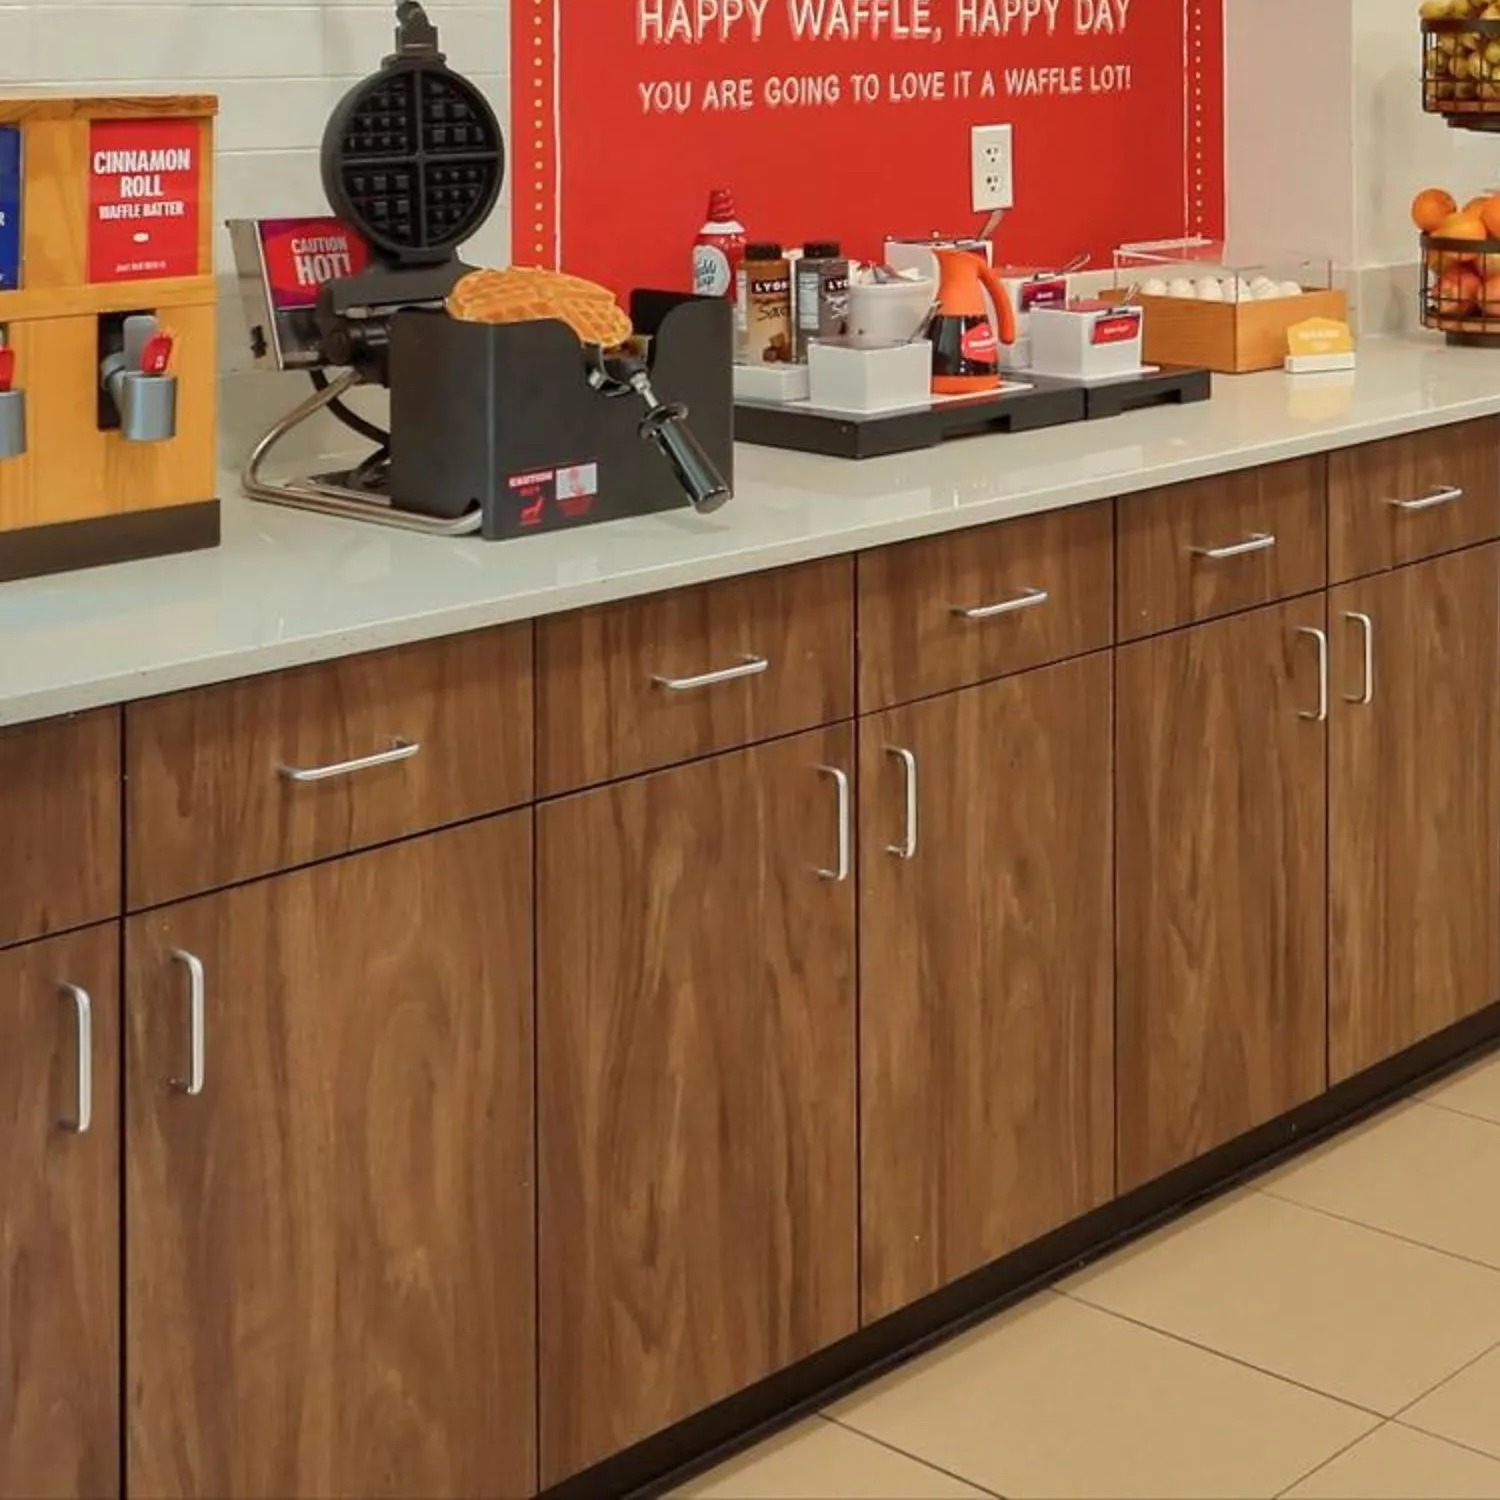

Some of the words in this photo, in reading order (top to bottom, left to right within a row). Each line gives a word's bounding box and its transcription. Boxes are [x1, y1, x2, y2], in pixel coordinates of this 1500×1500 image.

[639, 81, 692, 114] YOU
[701, 78, 753, 110] ARE
[764, 74, 841, 109] GOING
[851, 72, 880, 104] TO
[889, 71, 945, 102] LOVE
[954, 70, 973, 98] IT
[980, 70, 996, 98] A
[1005, 66, 1083, 97] WAFFLE
[1089, 65, 1132, 92] LOT!
[94, 148, 191, 173] CINNAMON
[120, 175, 163, 197] ROLL
[99, 203, 142, 220] WAFFLE
[143, 201, 183, 217] BATTER
[291, 235, 348, 254] CAUTION
